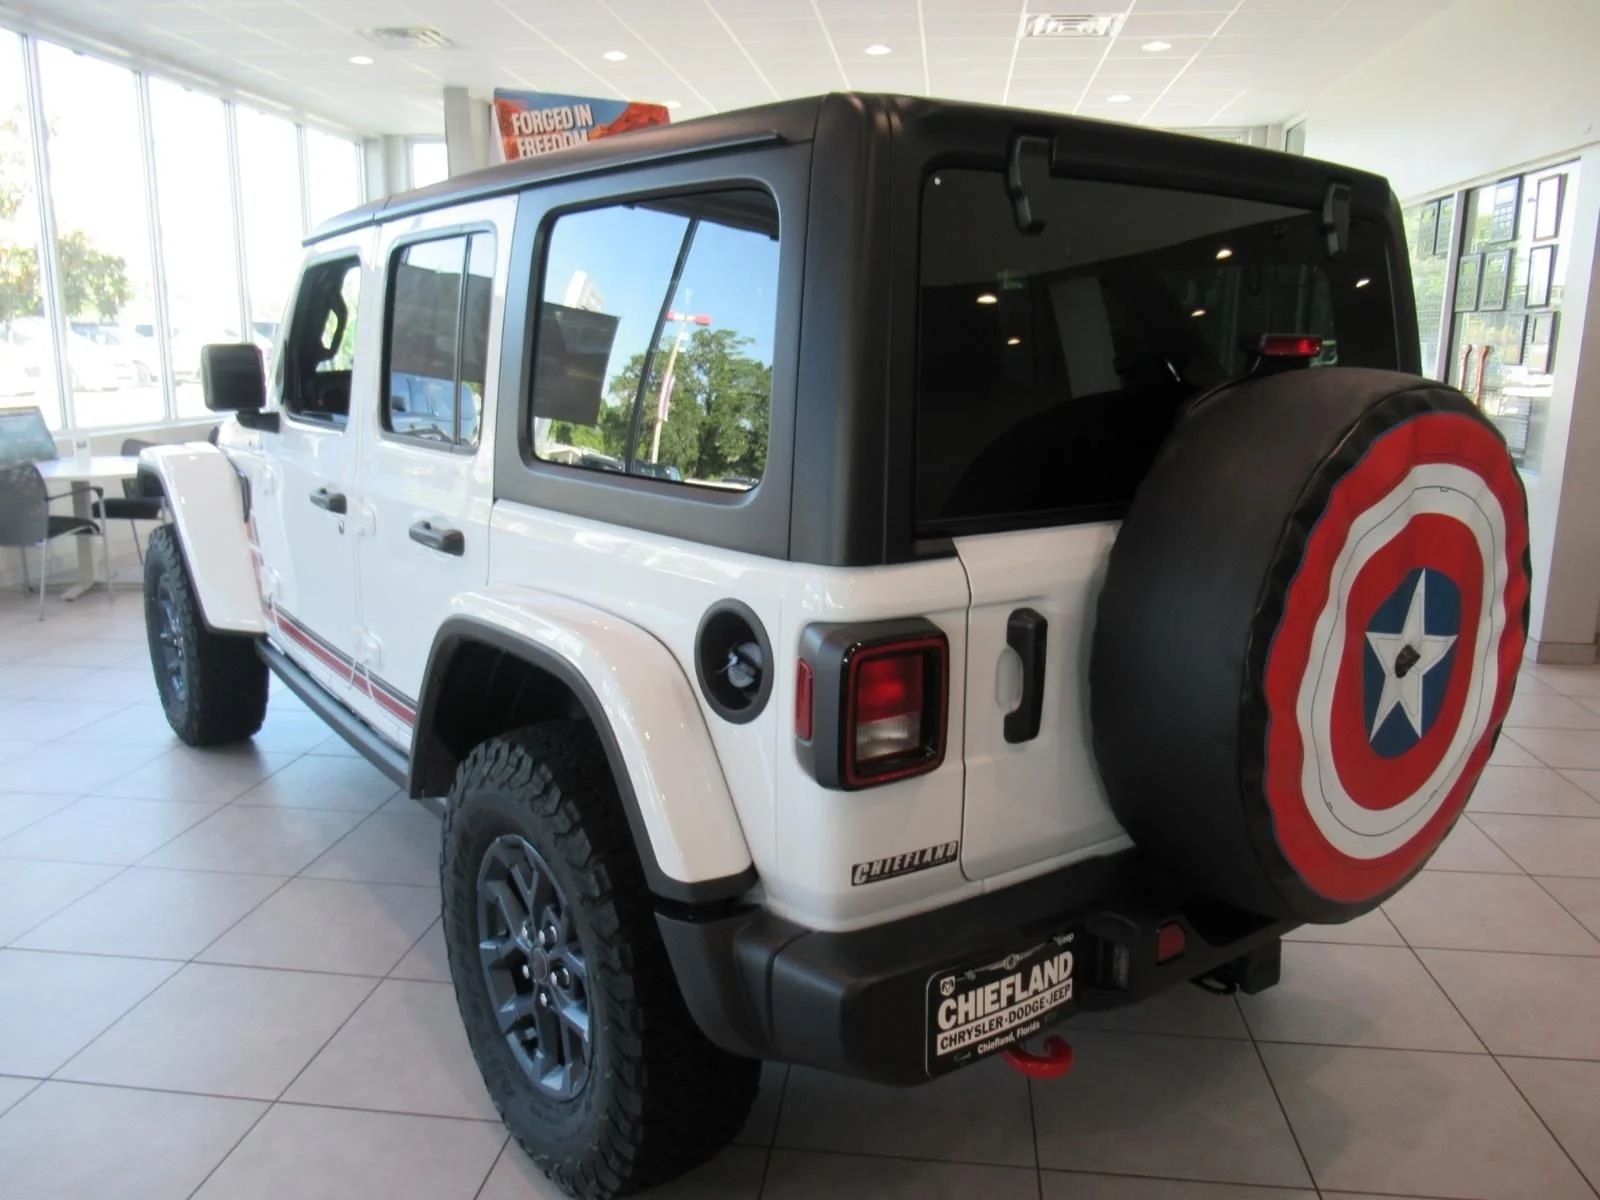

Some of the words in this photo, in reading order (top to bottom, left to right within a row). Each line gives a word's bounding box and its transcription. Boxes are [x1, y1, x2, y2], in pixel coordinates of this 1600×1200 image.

[511, 107, 574, 135] FORGED
[574, 104, 594, 127] IN
[853, 841, 957, 884] CHIEFLAND
[937, 951, 1073, 1030] CHIEFLAND
[1016, 1020, 1041, 1039] Florida
